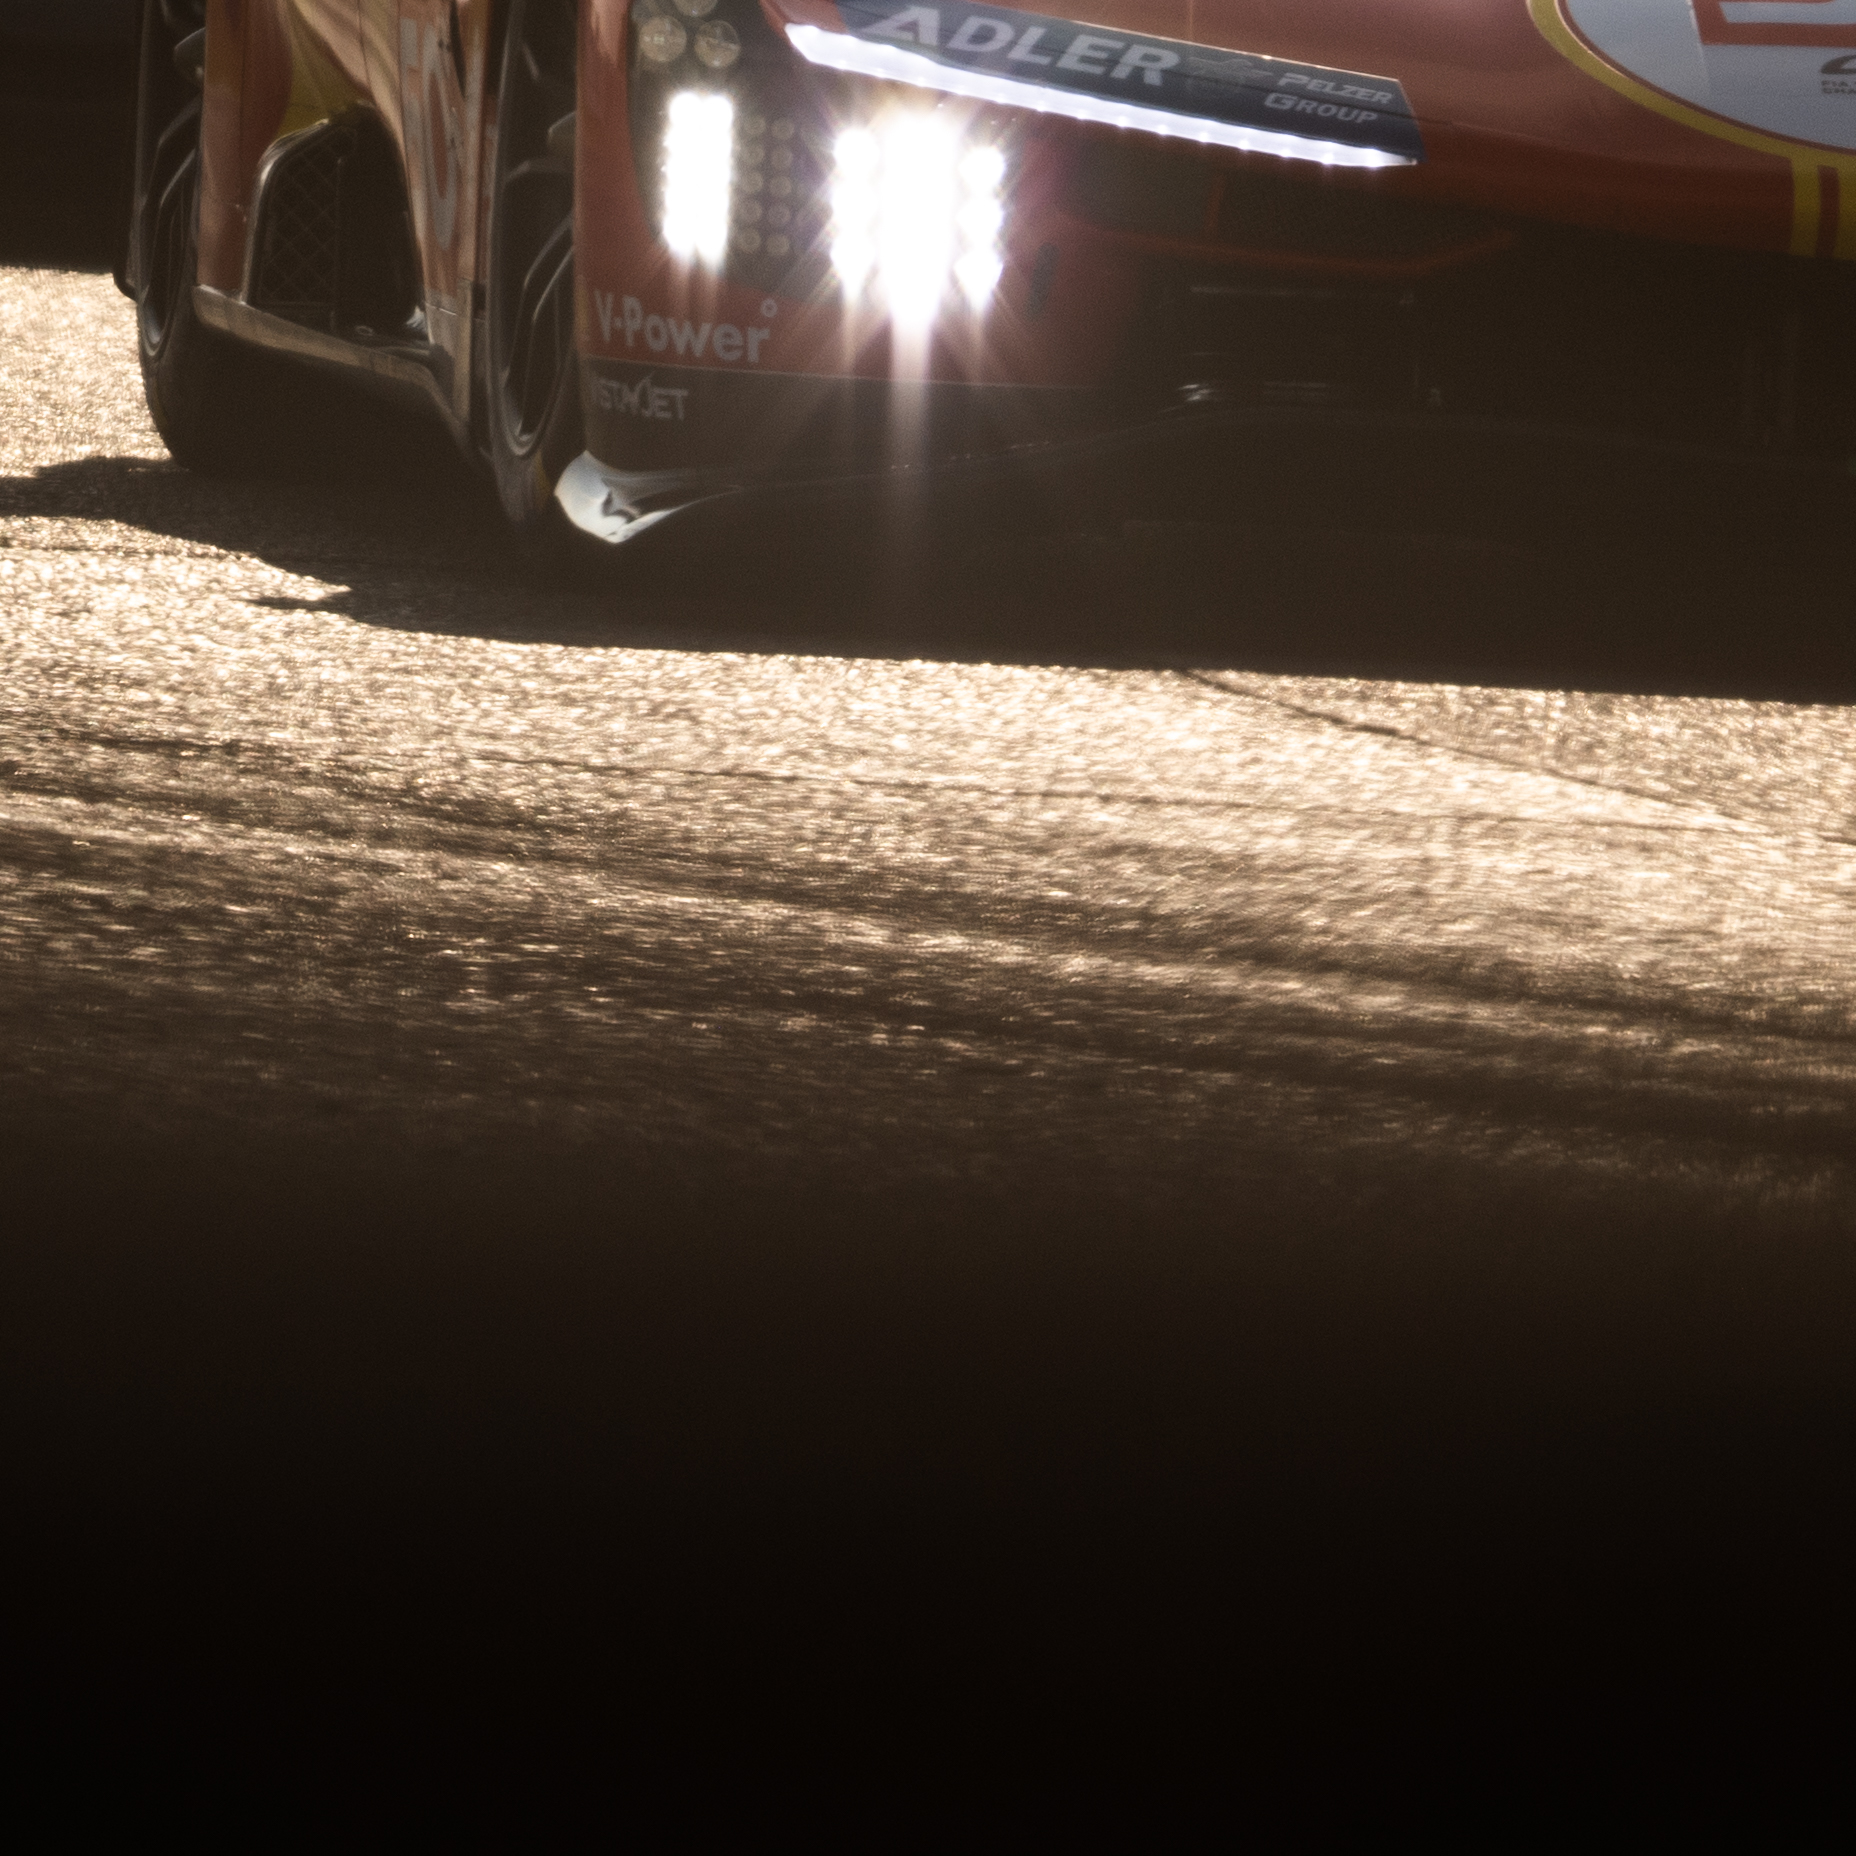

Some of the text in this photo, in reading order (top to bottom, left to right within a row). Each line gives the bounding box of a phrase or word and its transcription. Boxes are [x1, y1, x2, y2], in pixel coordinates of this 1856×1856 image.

[862, 5, 1182, 87] ADLER
[1821, 79, 1849, 88] FIA
[594, 289, 772, 364] V-Power
